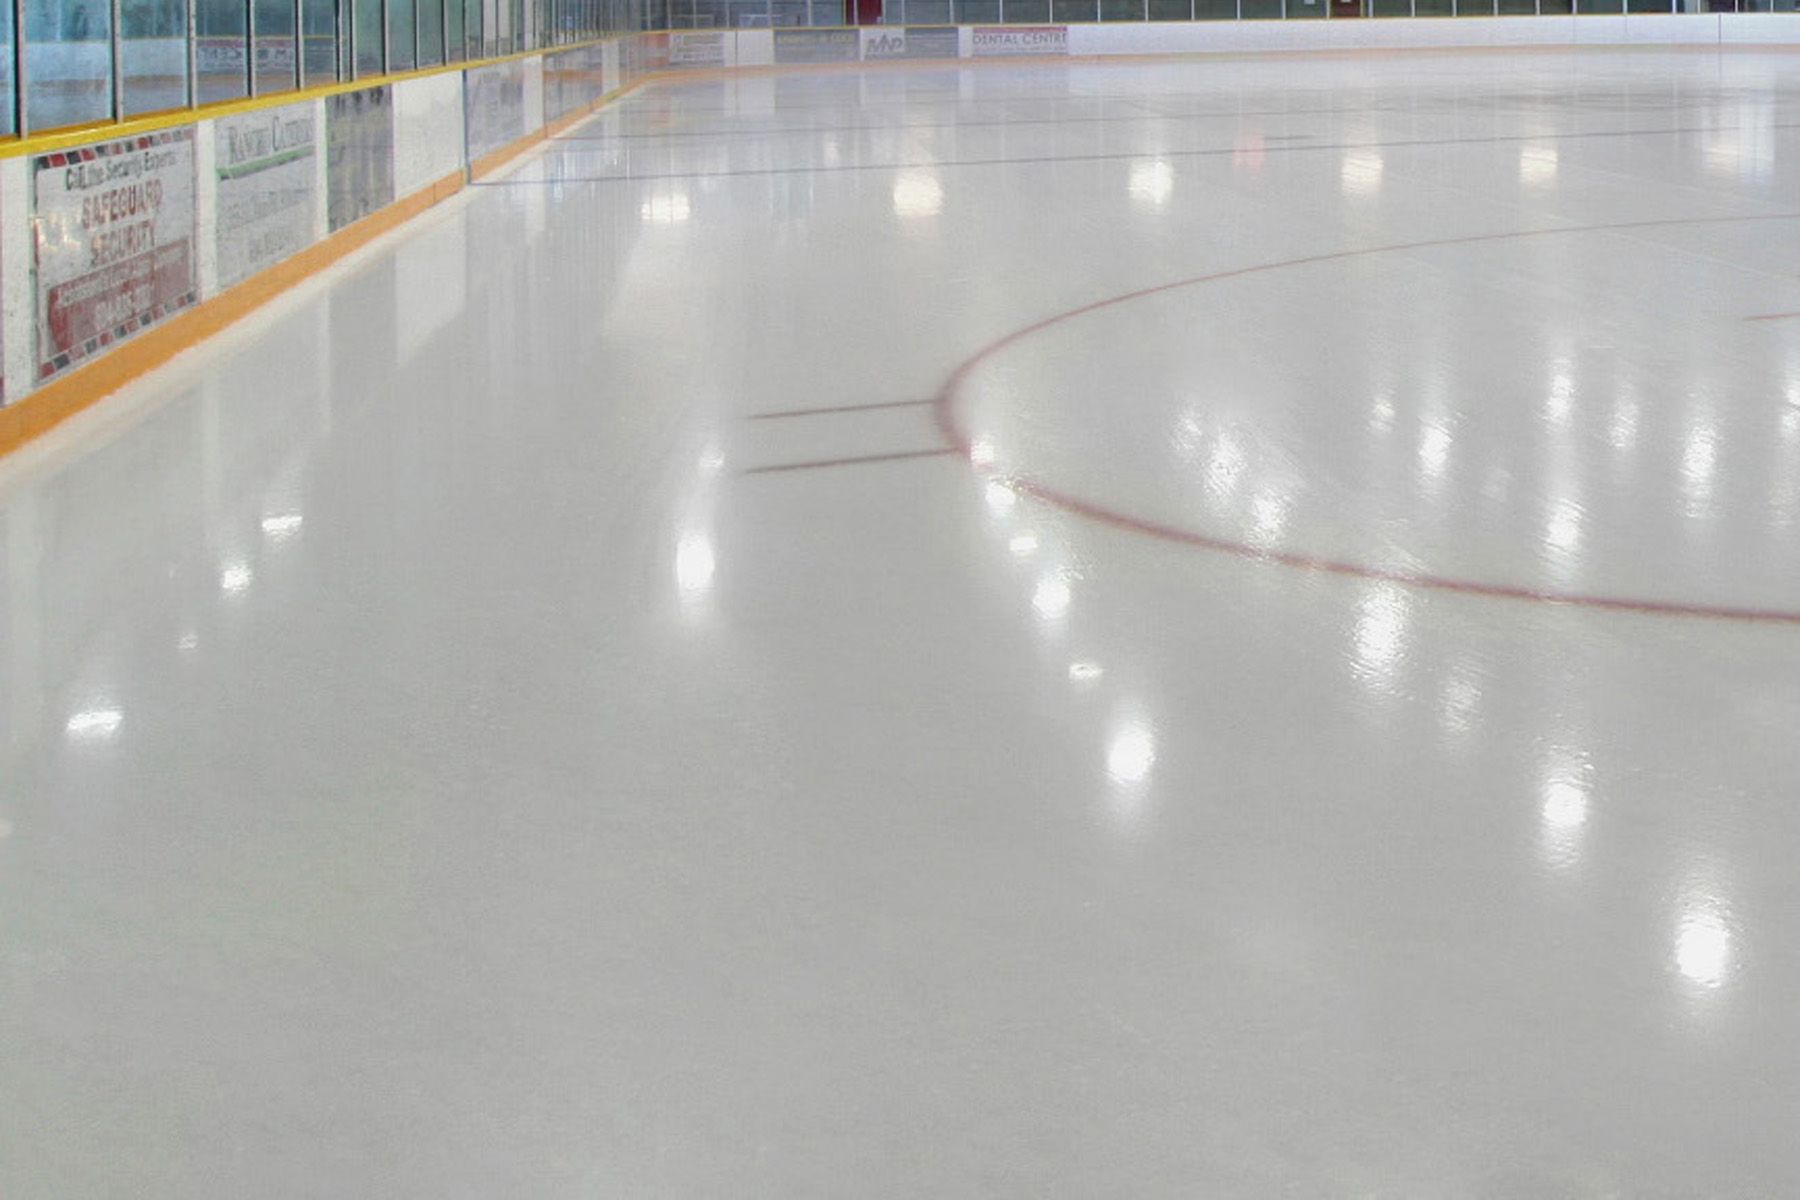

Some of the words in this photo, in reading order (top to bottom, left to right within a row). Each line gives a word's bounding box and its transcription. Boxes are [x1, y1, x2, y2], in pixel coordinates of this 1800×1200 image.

[972, 34, 1019, 46] DENTAL
[1022, 32, 1066, 45] CENTRE
[82, 178, 163, 230] SAFEGUARD
[92, 219, 155, 267] SECURITY
